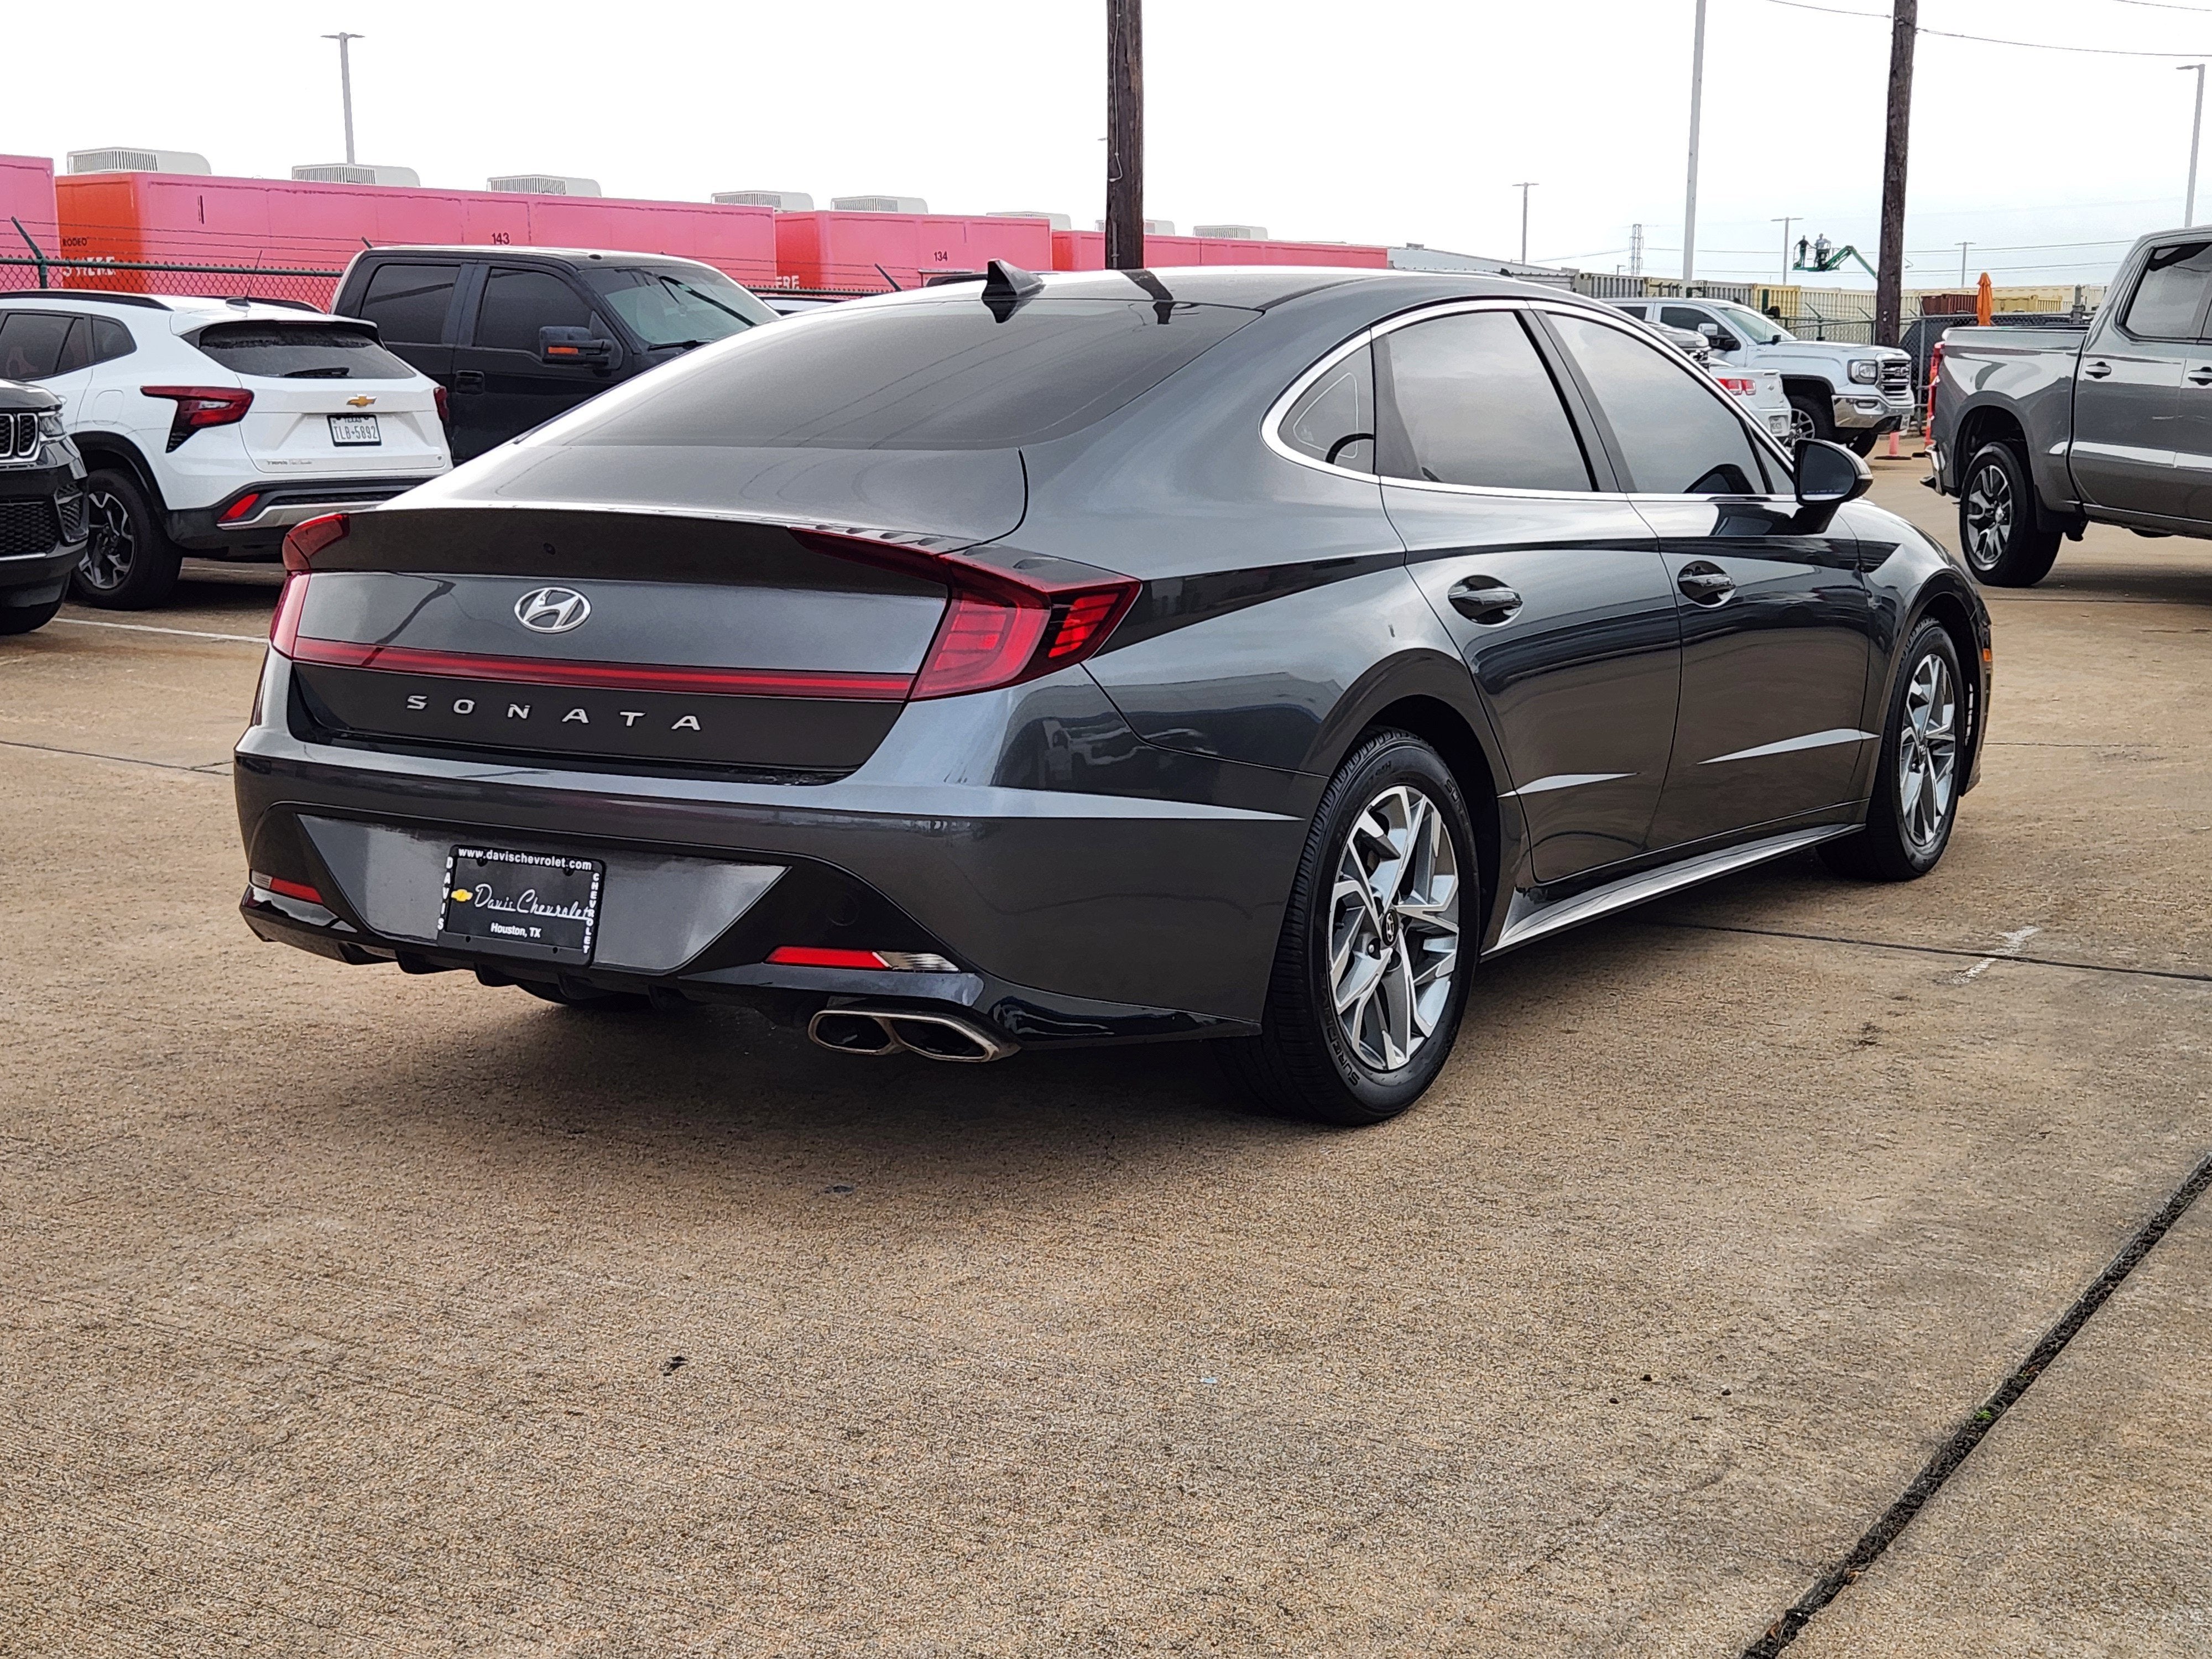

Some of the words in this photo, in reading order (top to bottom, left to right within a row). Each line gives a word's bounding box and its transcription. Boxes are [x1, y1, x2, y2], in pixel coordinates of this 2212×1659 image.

[492, 232, 510, 245] 143
[933, 251, 948, 262] 134
[407, 695, 701, 731] SONATA
[458, 847, 592, 871] www.davischevrolet.com
[437, 856, 453, 930] DAVIS
[473, 883, 517, 912] Davis
[517, 889, 590, 920] Chevrolet
[583, 872, 600, 954] CHEVROLET
[491, 922, 528, 938] Houston,
[529, 927, 542, 938] TX
